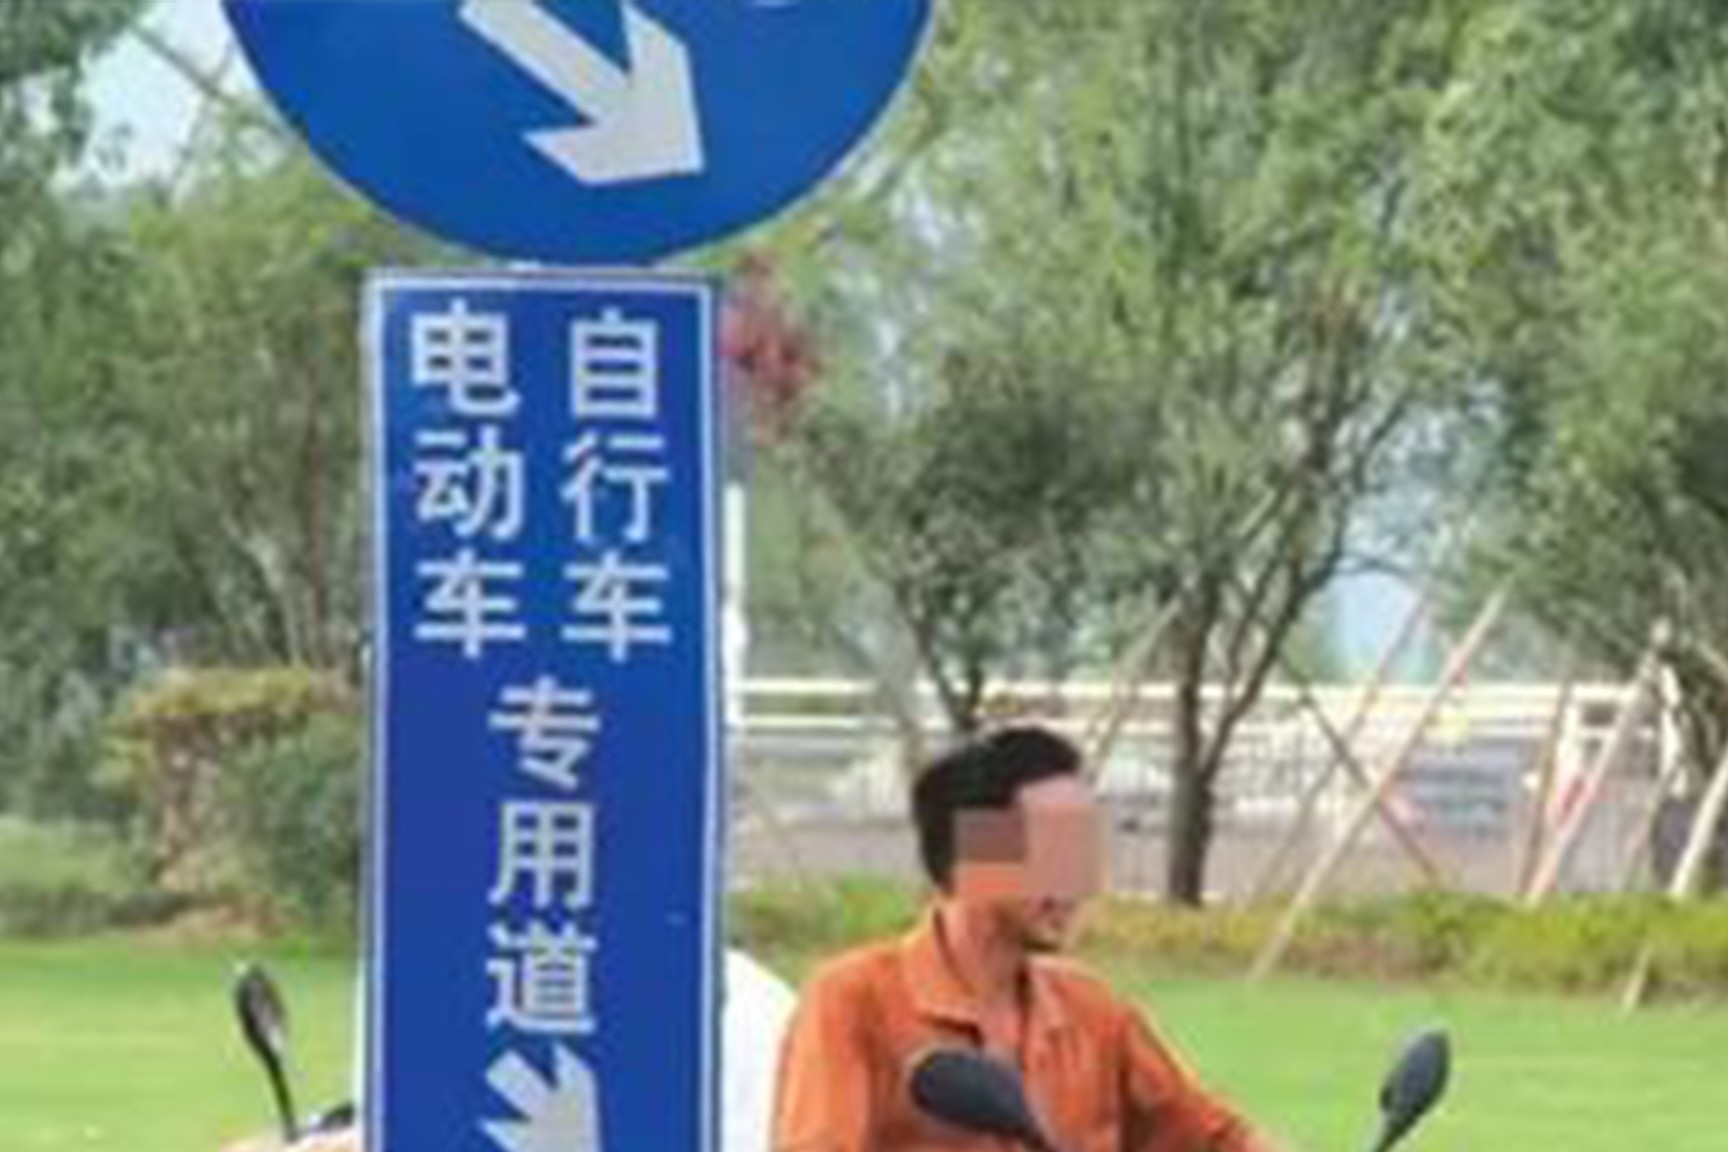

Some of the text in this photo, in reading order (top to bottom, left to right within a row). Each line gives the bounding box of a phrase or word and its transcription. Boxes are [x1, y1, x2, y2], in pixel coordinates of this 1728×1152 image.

[410, 298, 526, 658] 电动车
[559, 309, 672, 662] 自行车
[487, 676, 600, 1034] 专用道
